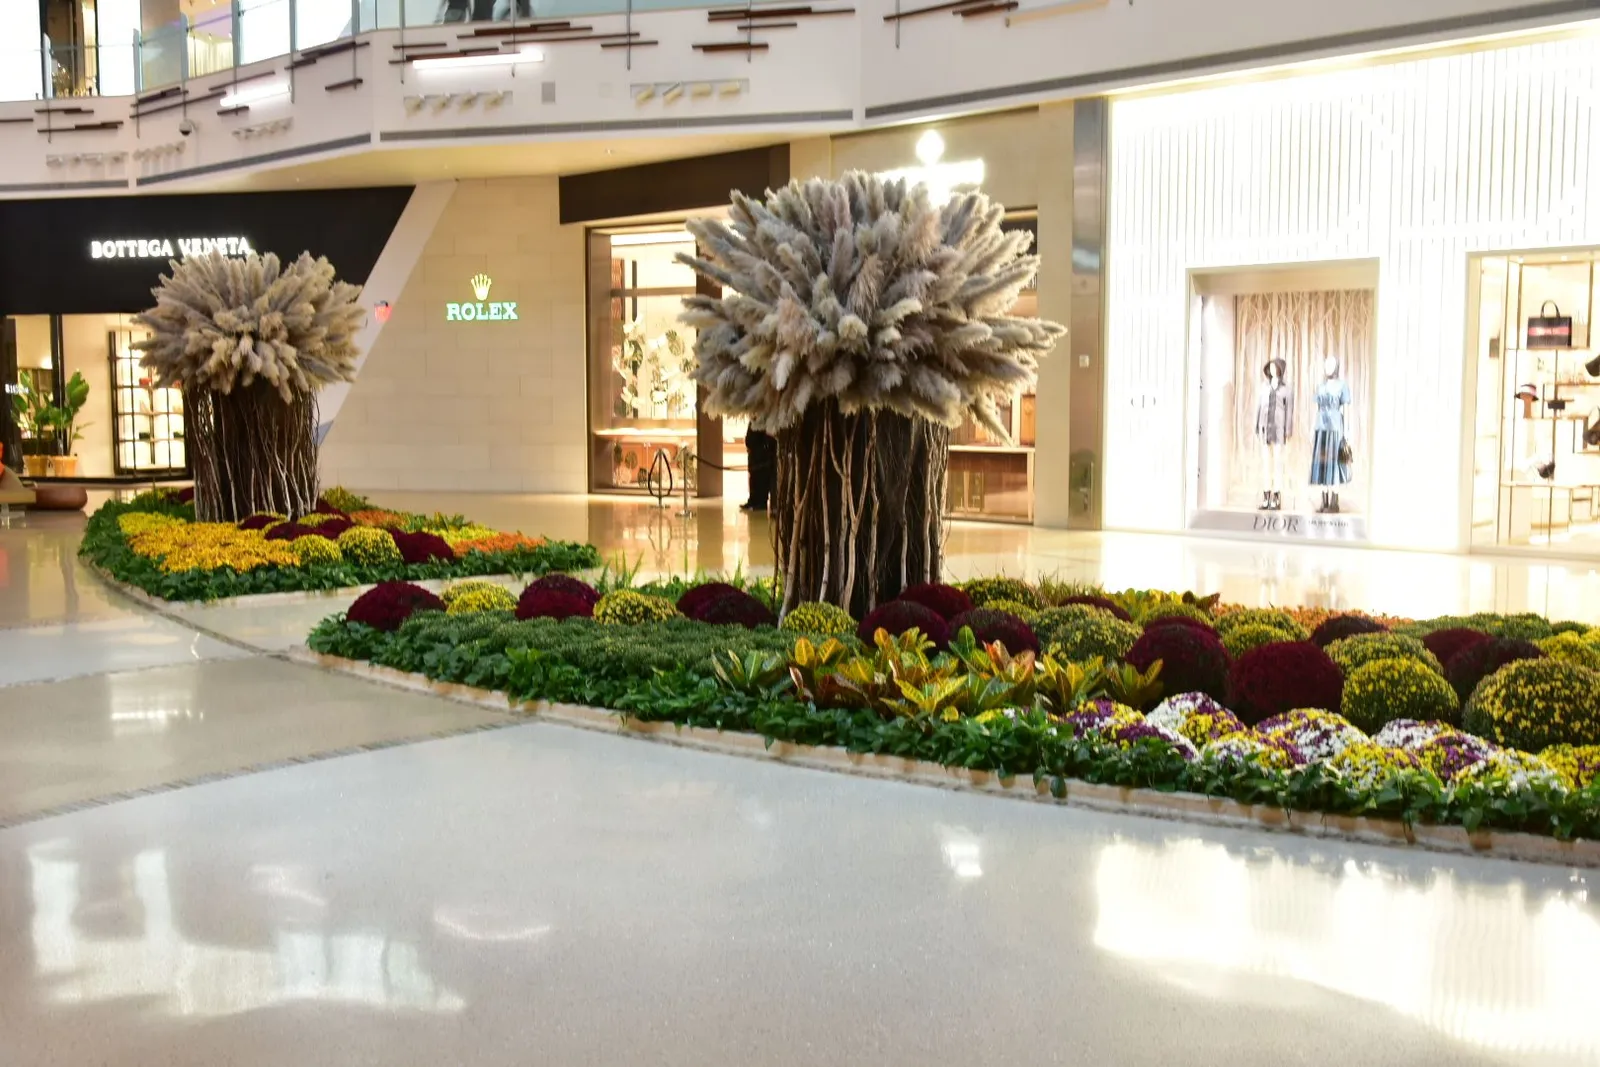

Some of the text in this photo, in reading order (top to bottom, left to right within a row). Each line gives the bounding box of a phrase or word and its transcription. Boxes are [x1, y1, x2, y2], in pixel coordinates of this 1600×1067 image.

[91, 239, 174, 258] BOTTEGA
[446, 302, 519, 321] ROLEX
[1253, 515, 1299, 532] DIOR
